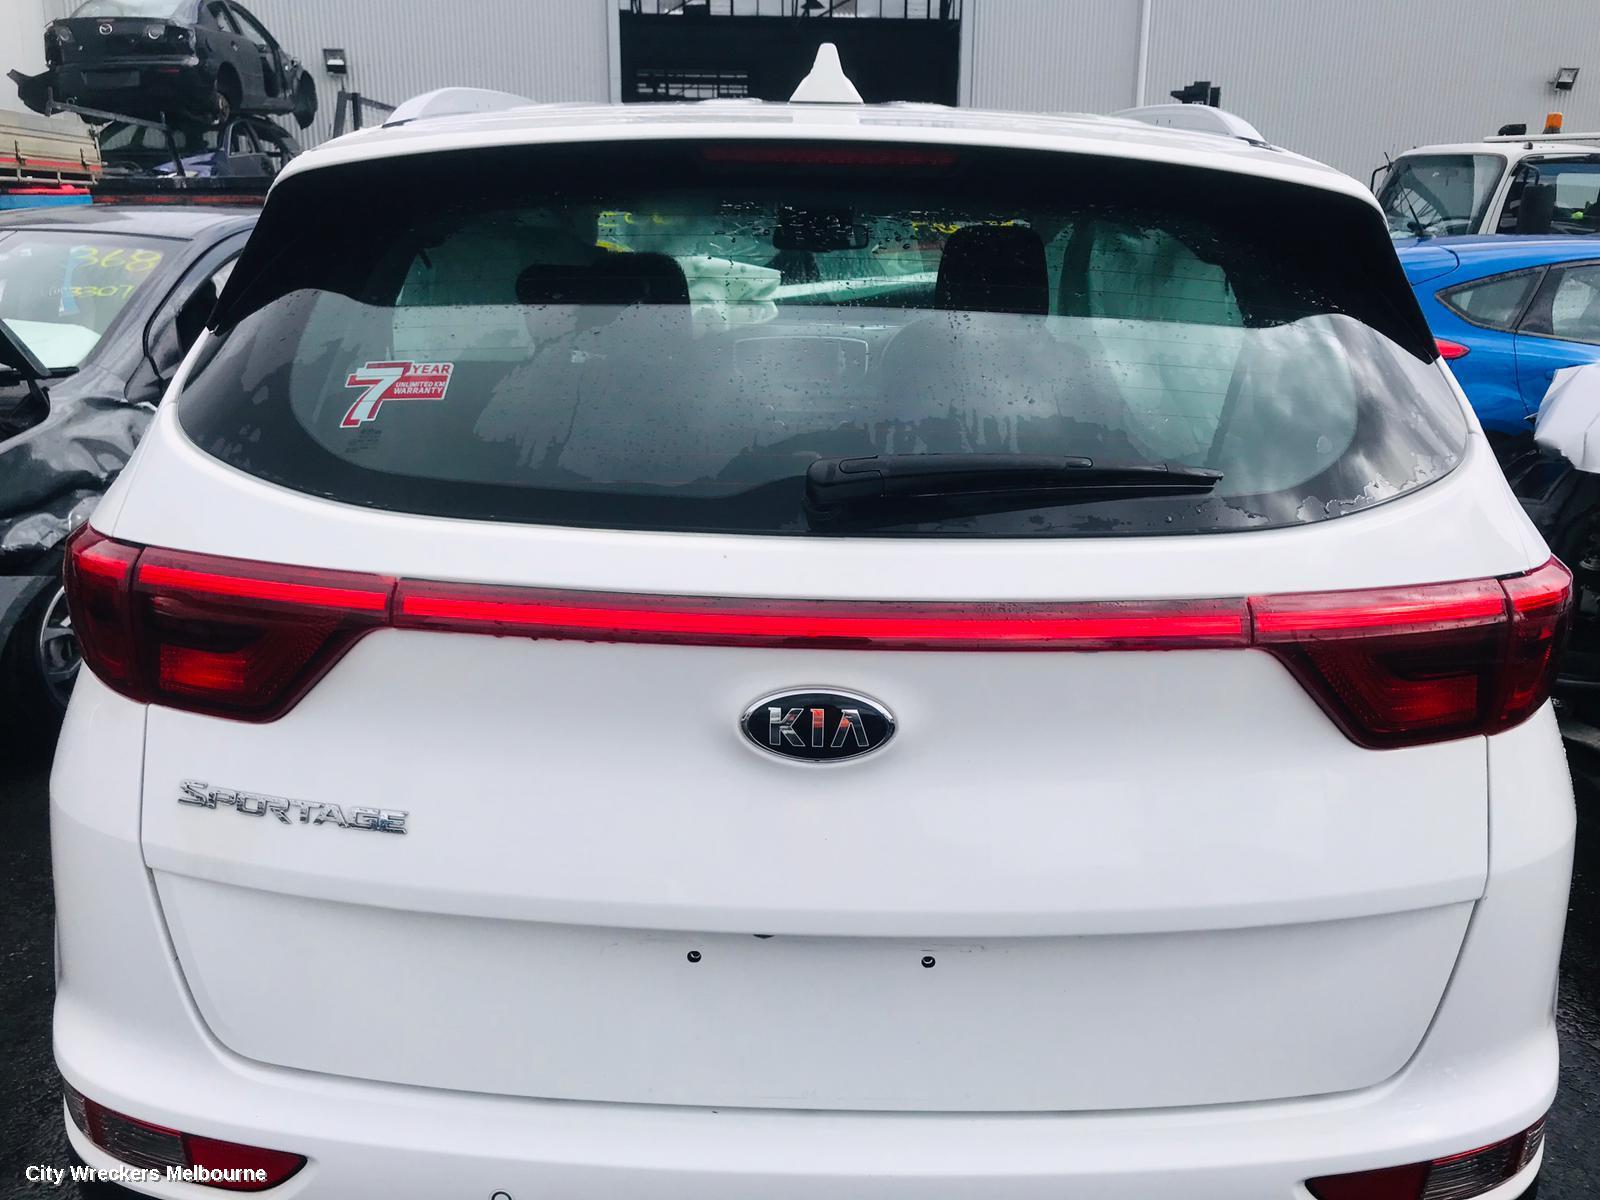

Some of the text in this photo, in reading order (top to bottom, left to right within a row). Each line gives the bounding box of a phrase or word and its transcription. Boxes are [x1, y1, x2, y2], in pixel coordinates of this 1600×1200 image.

[344, 361, 451, 426] 7 YEAR
[768, 707, 869, 748] KIA
[178, 780, 409, 835] SPORTAGE
